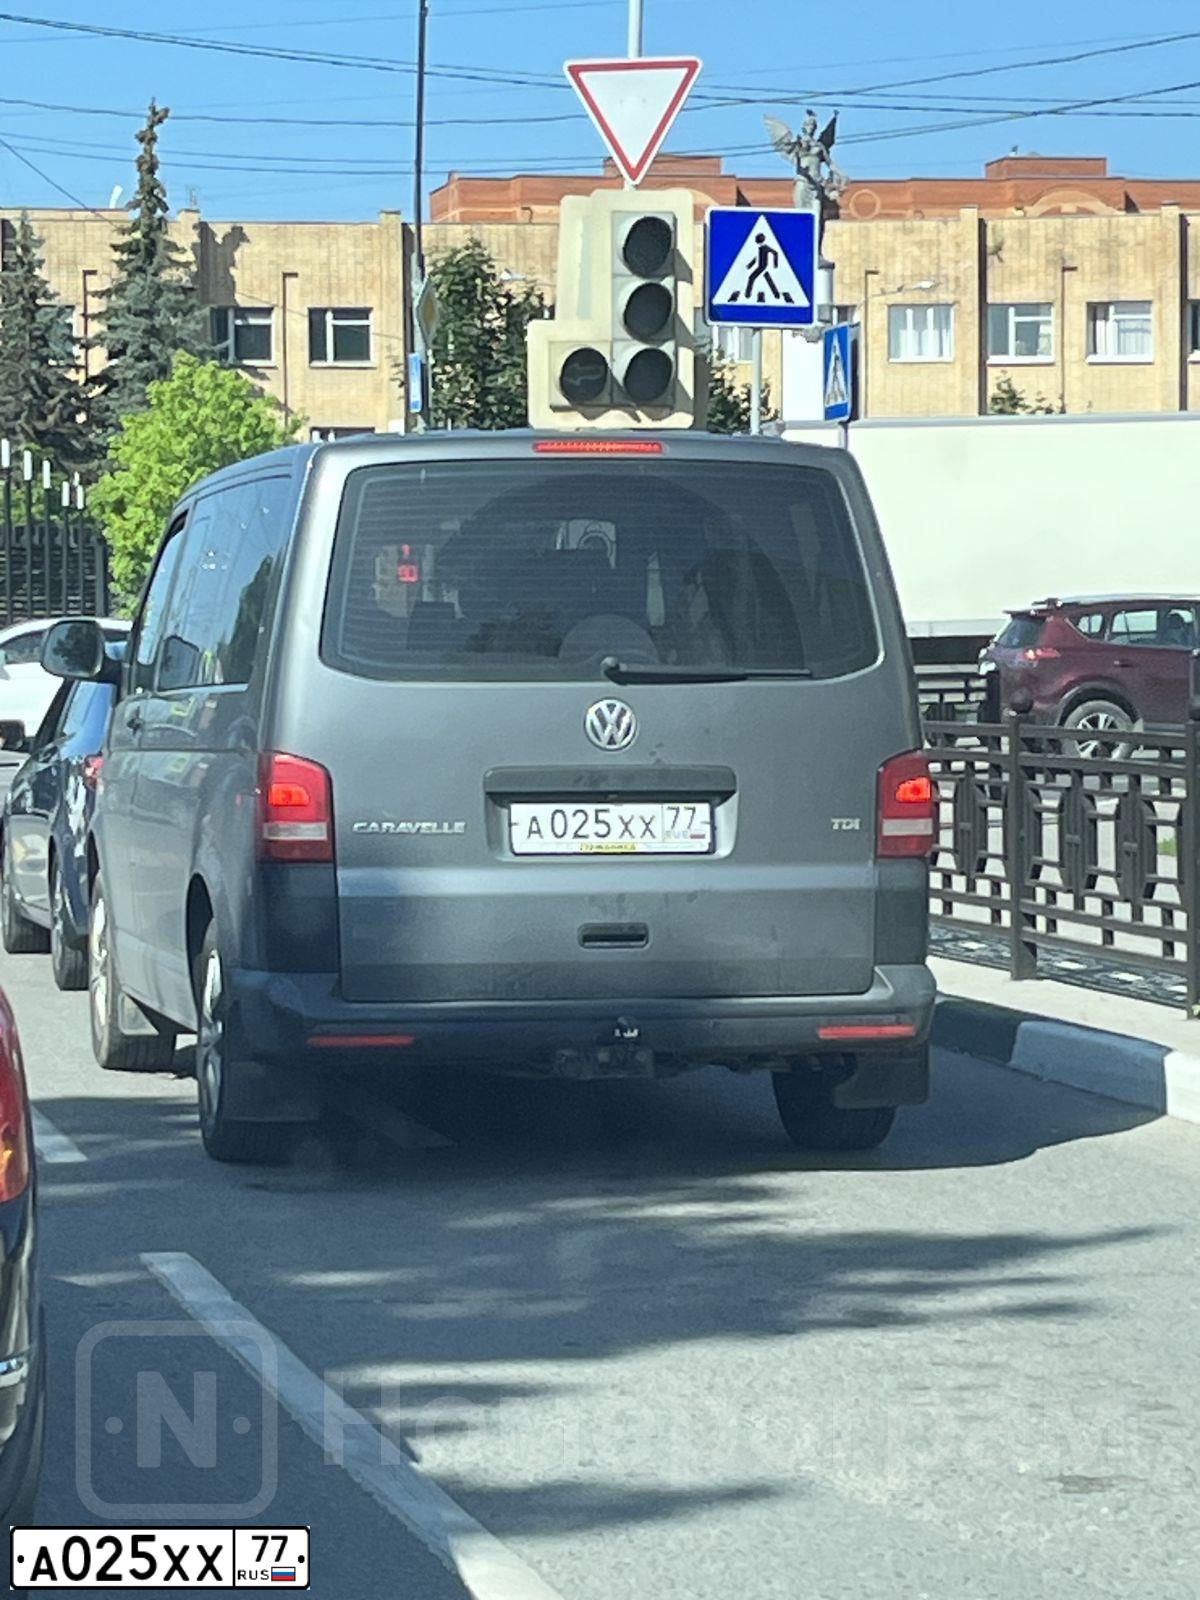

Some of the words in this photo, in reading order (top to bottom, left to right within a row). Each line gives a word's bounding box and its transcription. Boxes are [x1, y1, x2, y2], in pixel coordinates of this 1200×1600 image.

[666, 805, 697, 830] 77
[830, 817, 861, 831] TDI
[352, 821, 466, 834] CARAVELLE
